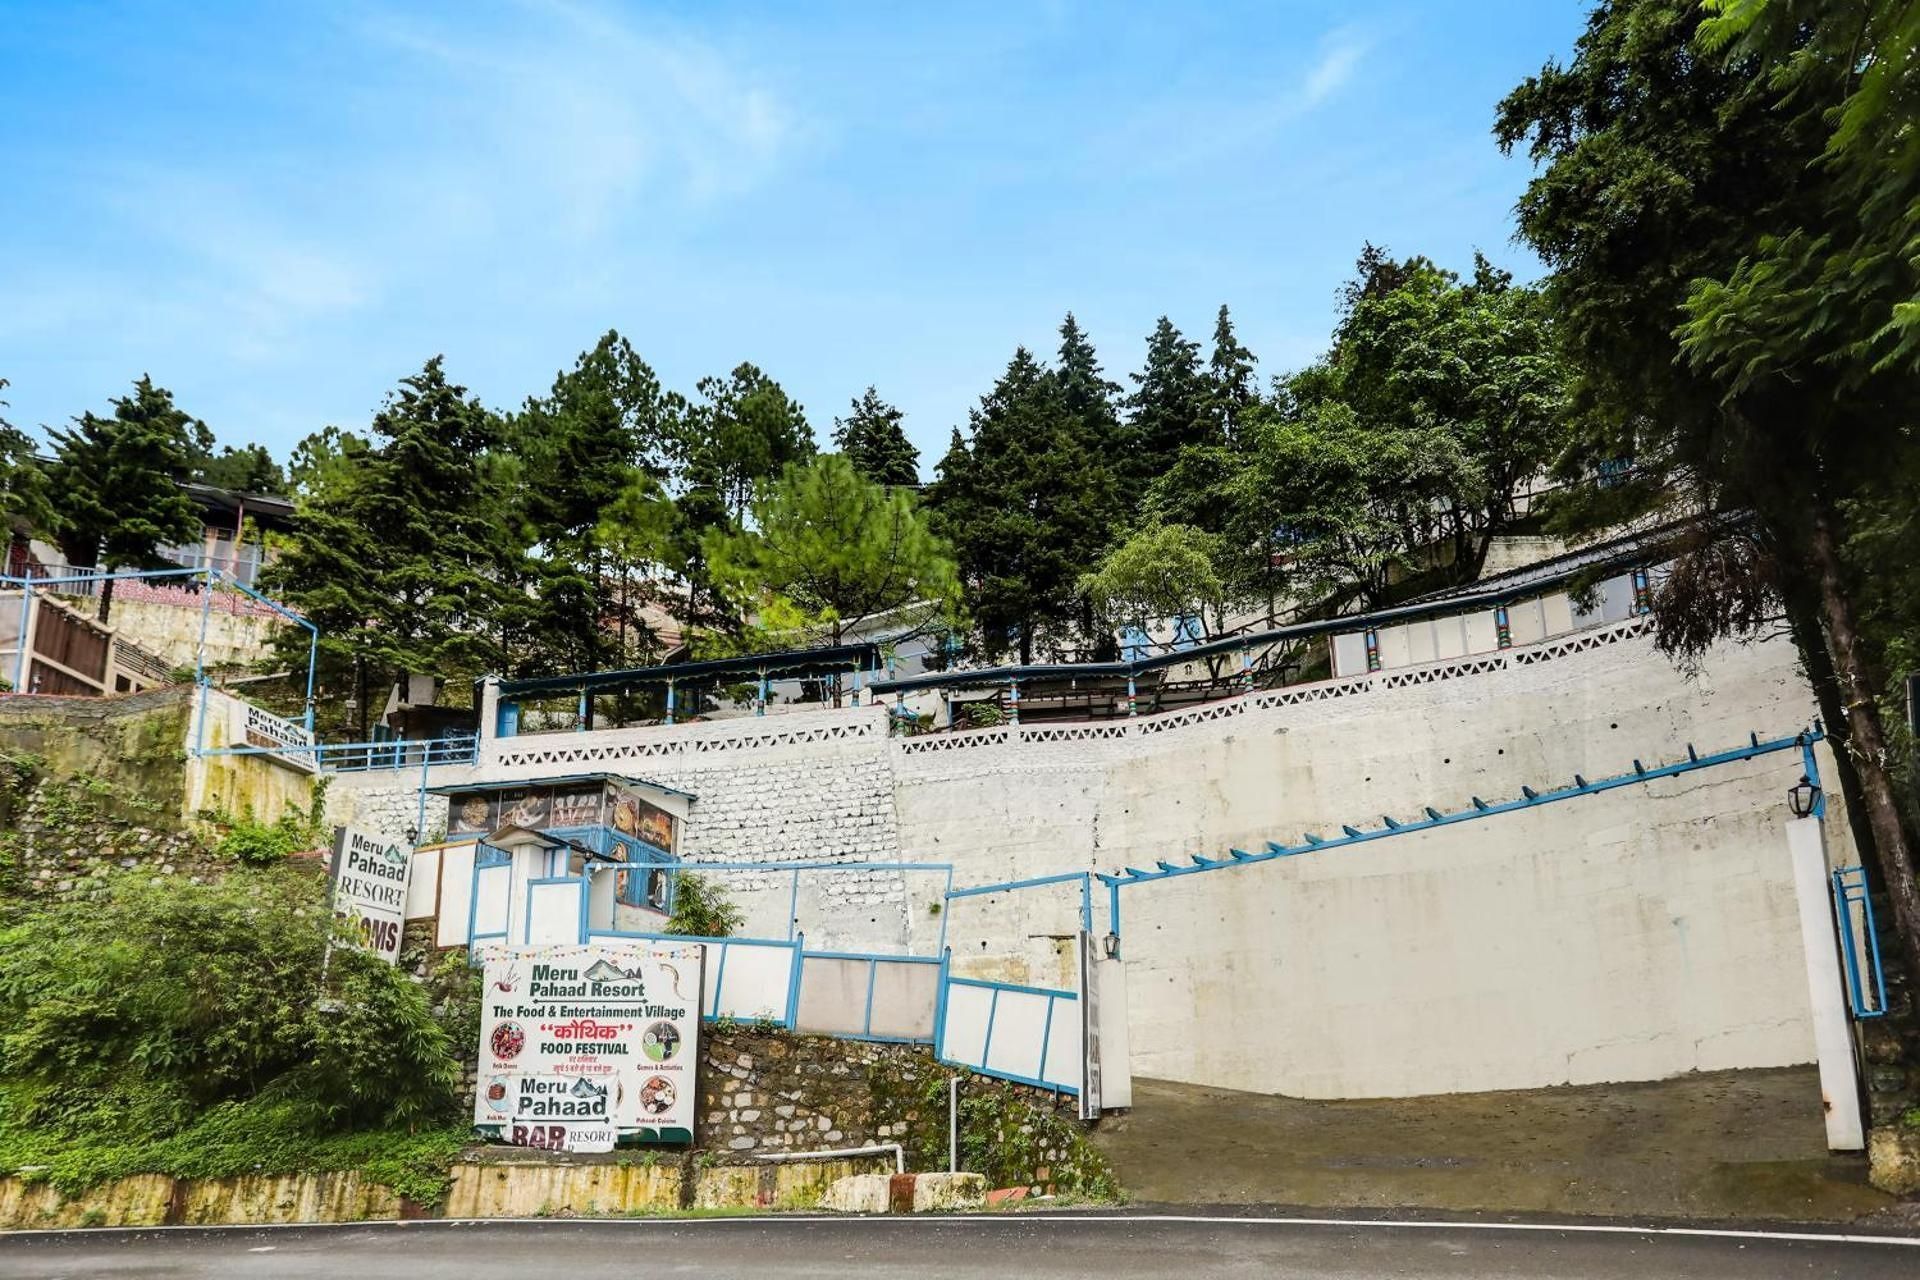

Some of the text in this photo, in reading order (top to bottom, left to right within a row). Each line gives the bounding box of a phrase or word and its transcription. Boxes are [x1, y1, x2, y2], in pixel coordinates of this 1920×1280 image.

[248, 707, 281, 728] Meru
[248, 716, 307, 747] Pahaad
[351, 833, 384, 856] Meru
[348, 851, 406, 882] Pahaad
[339, 875, 404, 907] RESORT
[532, 964, 578, 981] Meru
[529, 982, 645, 997] Pahaad Resort
[493, 1005, 686, 1020] The Food & Entertainment Village
[540, 1042, 629, 1055] FOOD FESTIVAL
[520, 1078, 567, 1094] Meru
[518, 1096, 606, 1116] Pahaad
[512, 1126, 612, 1149] BAR RESORT
